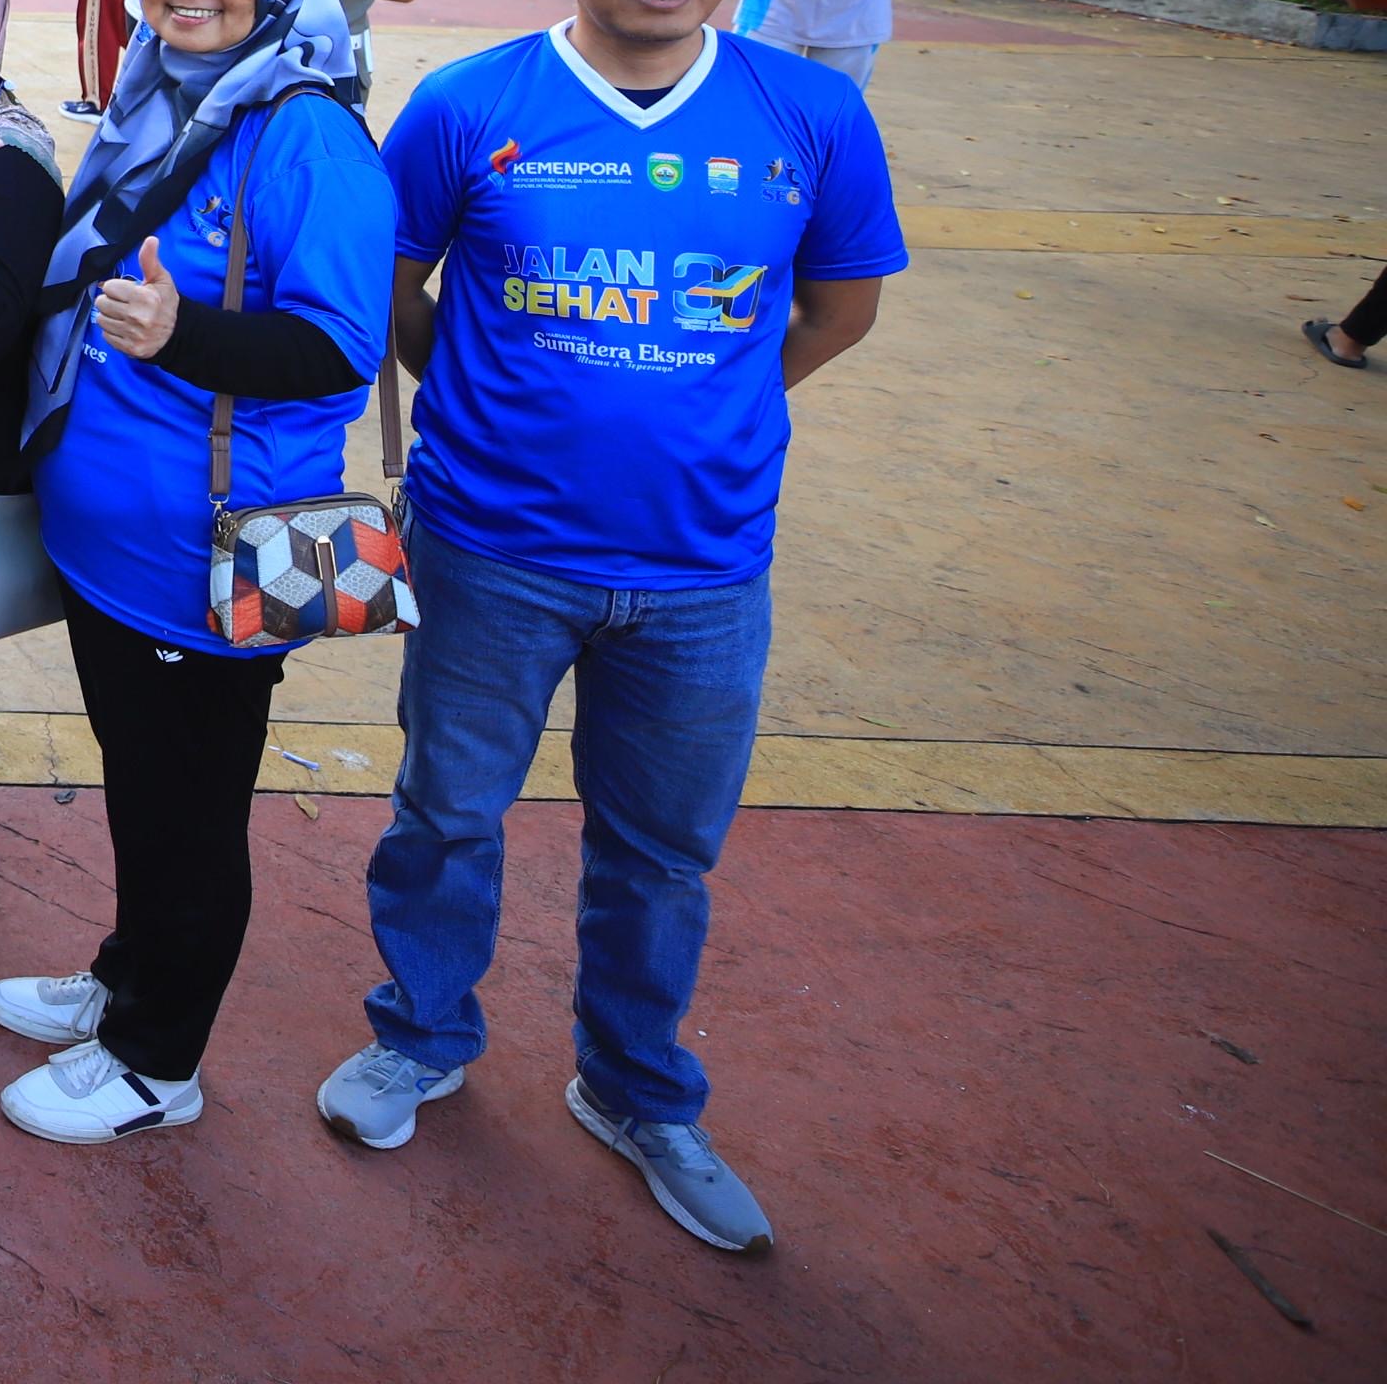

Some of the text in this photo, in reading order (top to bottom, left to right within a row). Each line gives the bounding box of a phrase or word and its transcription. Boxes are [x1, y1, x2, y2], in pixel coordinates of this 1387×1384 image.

[513, 162, 632, 175] KEMENPORA
[504, 244, 655, 286] JALAN
[503, 278, 658, 325] SEHAT
[533, 332, 716, 367] Sumatera Ekspres
